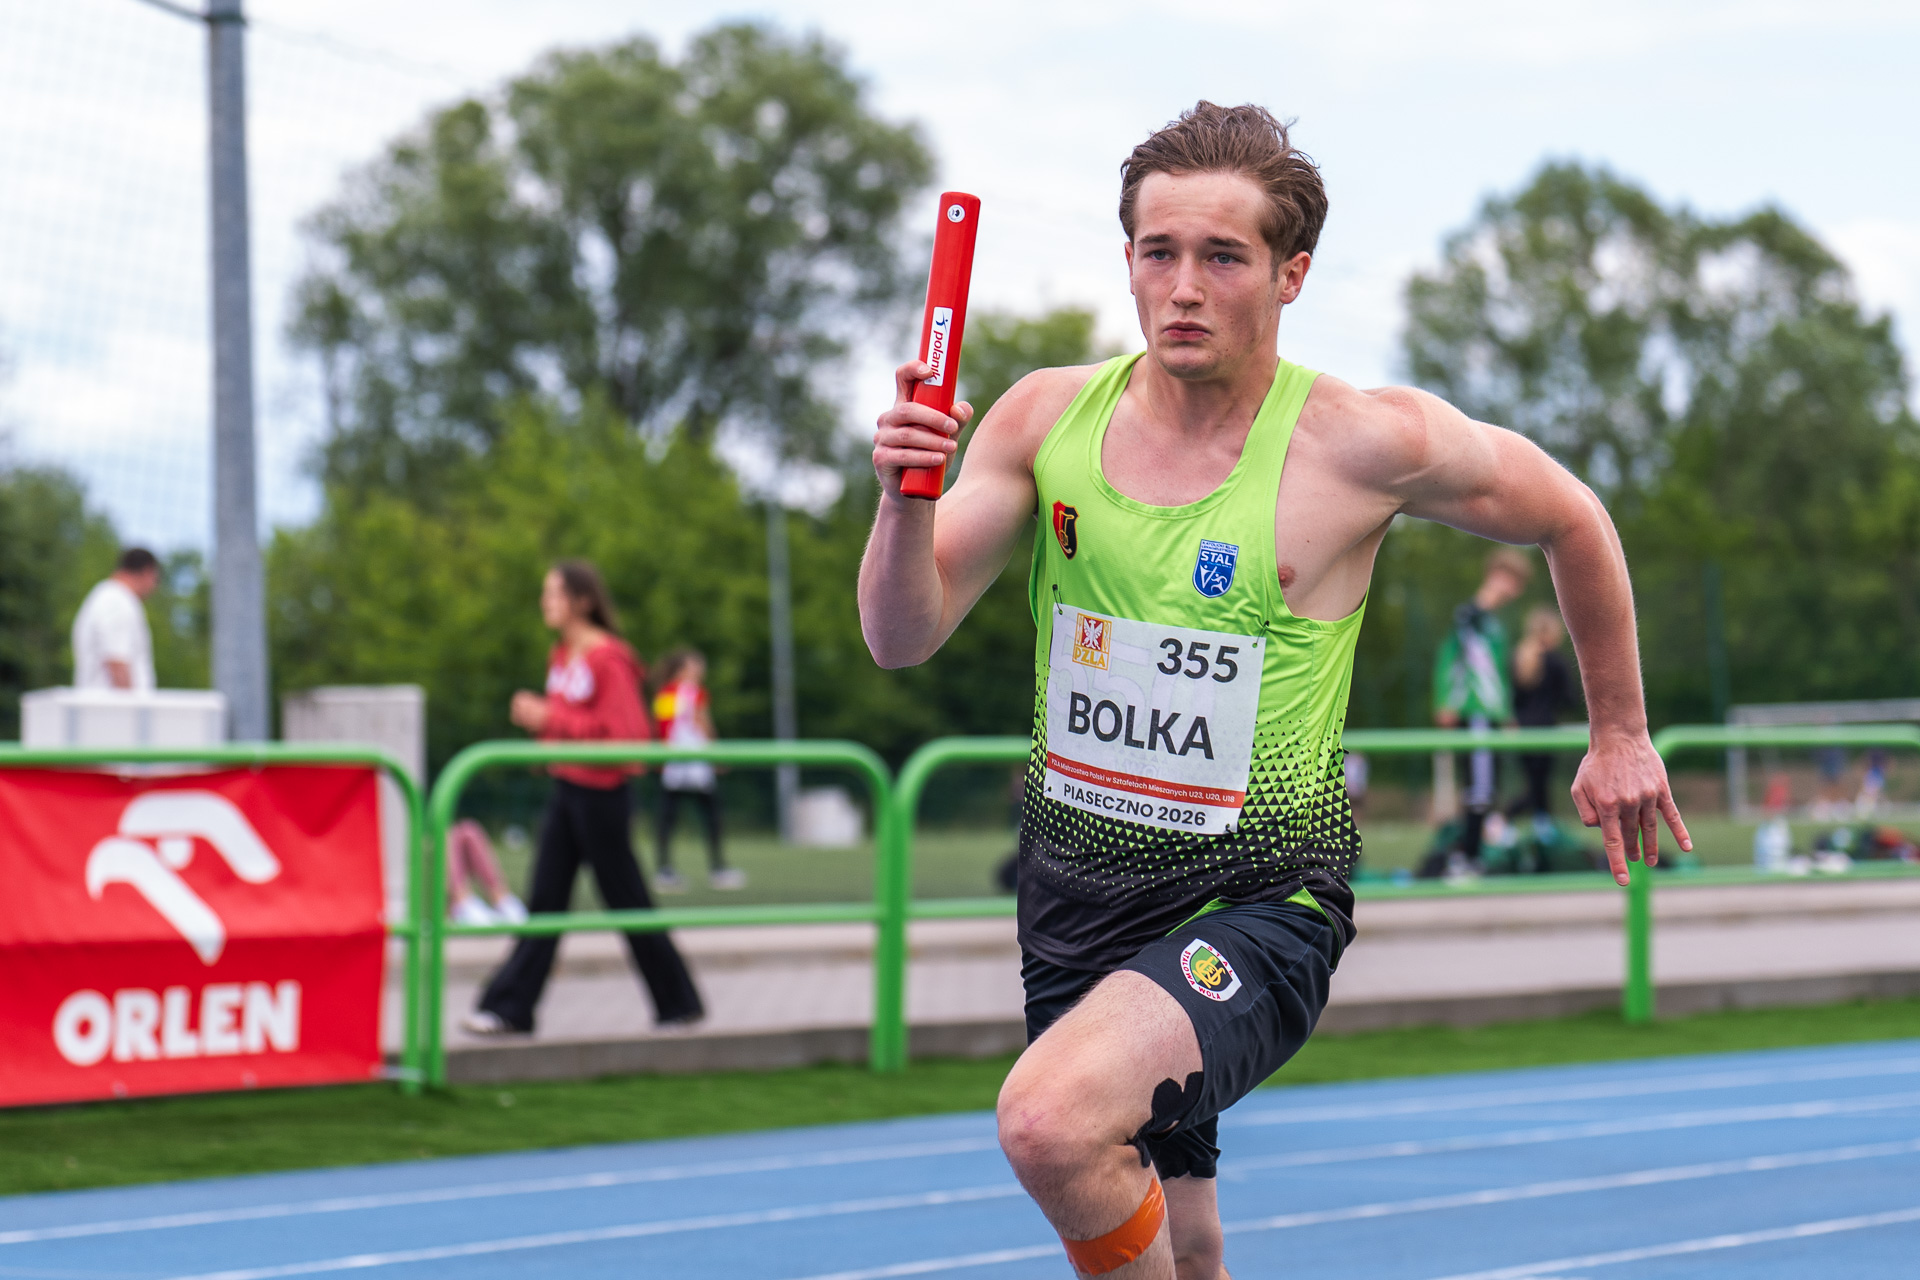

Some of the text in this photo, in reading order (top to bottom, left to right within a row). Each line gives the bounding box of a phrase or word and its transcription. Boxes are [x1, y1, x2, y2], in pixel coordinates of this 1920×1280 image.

[931, 329, 944, 380] polanik
[1200, 550, 1233, 566] STAL
[1074, 646, 1106, 668] PZLA
[1156, 637, 1240, 683] 355
[1068, 690, 1215, 760] BOLKA
[1060, 762, 1089, 777] Mistrzostwa
[1089, 771, 1105, 781] Polski
[1112, 777, 1147, 790] Sztafetach
[1148, 783, 1188, 797] Mieszanych
[1188, 790, 1205, 800] U23,
[1205, 793, 1221, 802] U20,
[1222, 795, 1235, 803] U18
[1063, 783, 1206, 826] PIASECZNO 2026
[1182, 950, 1221, 1000] STALOWA WOLA
[53, 979, 302, 1067] ORLEN
